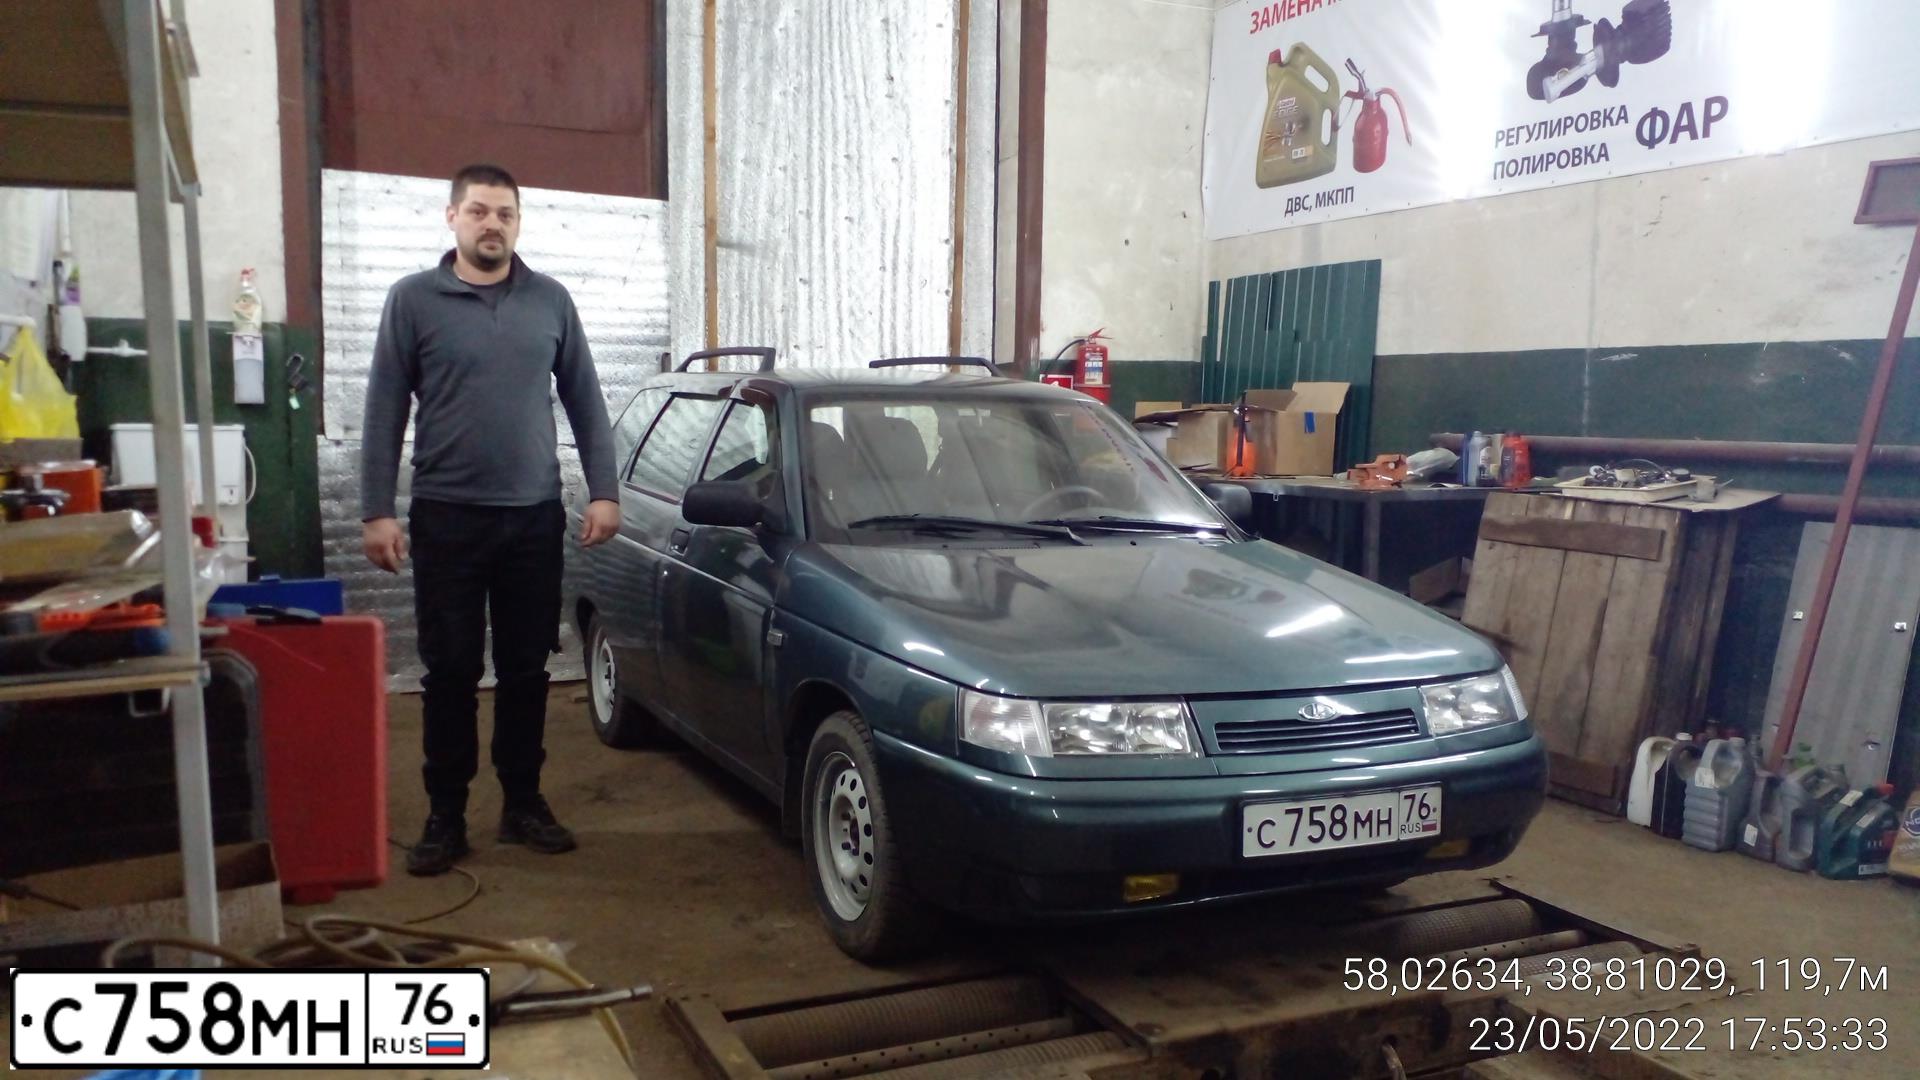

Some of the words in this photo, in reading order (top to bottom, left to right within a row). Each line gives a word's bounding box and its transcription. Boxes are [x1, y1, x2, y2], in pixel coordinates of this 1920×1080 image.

[1495, 104, 1630, 149] РЕГУЛИРОВКА
[1635, 95, 1729, 150] ФАР
[1493, 142, 1610, 180] ПОЛИРОВКА
[1284, 195, 1312, 217] ДВС,
[1315, 186, 1355, 209] МКПП
[1403, 792, 1431, 822] 76
[1400, 822, 1421, 833] RUS
